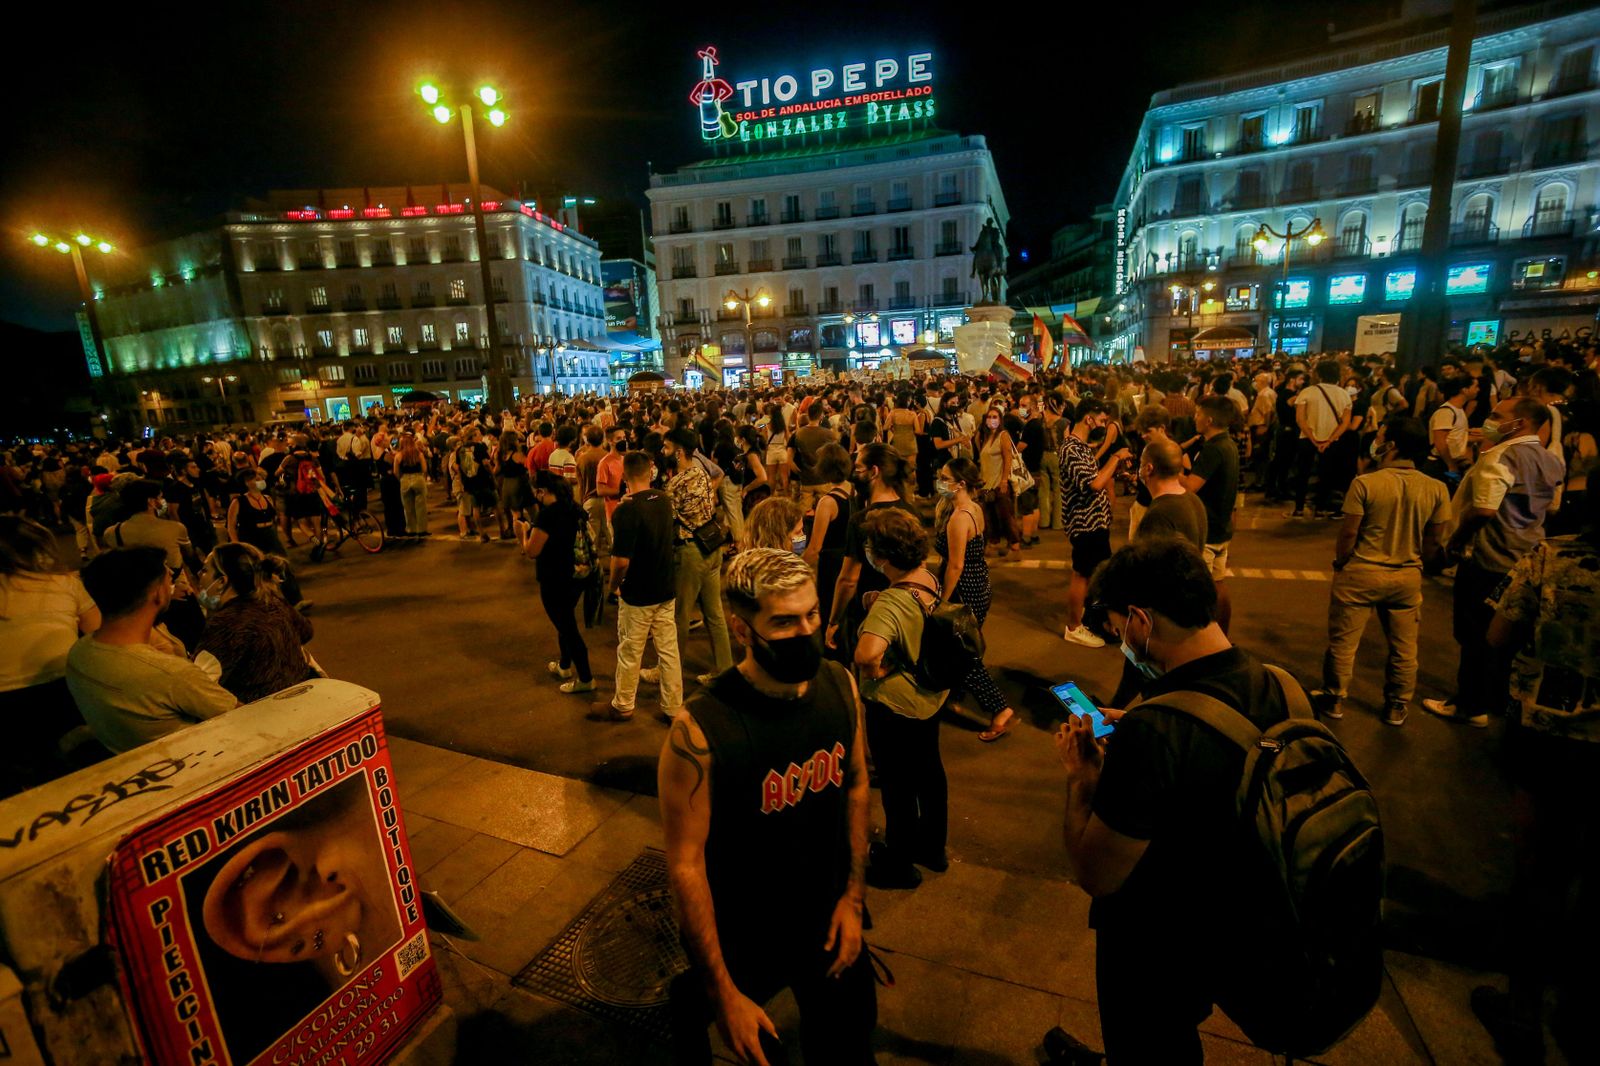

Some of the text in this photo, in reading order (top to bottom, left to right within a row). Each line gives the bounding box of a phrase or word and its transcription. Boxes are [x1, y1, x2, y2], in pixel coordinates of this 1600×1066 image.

[735, 85, 933, 122] SOL DE ANDALUCIA EMBOTELLADO
[736, 53, 933, 108] TIO PEPE
[739, 99, 935, 142] GONZALEZ BYASS
[1117, 208, 1125, 247] HOTEL
[140, 734, 378, 885] RED KIRIN TATTOO
[372, 766, 419, 925] BOUTIQUE
[148, 896, 218, 1066] PIERCIN
[354, 1031, 375, 1059] 29
[380, 1010, 399, 1035] 31
